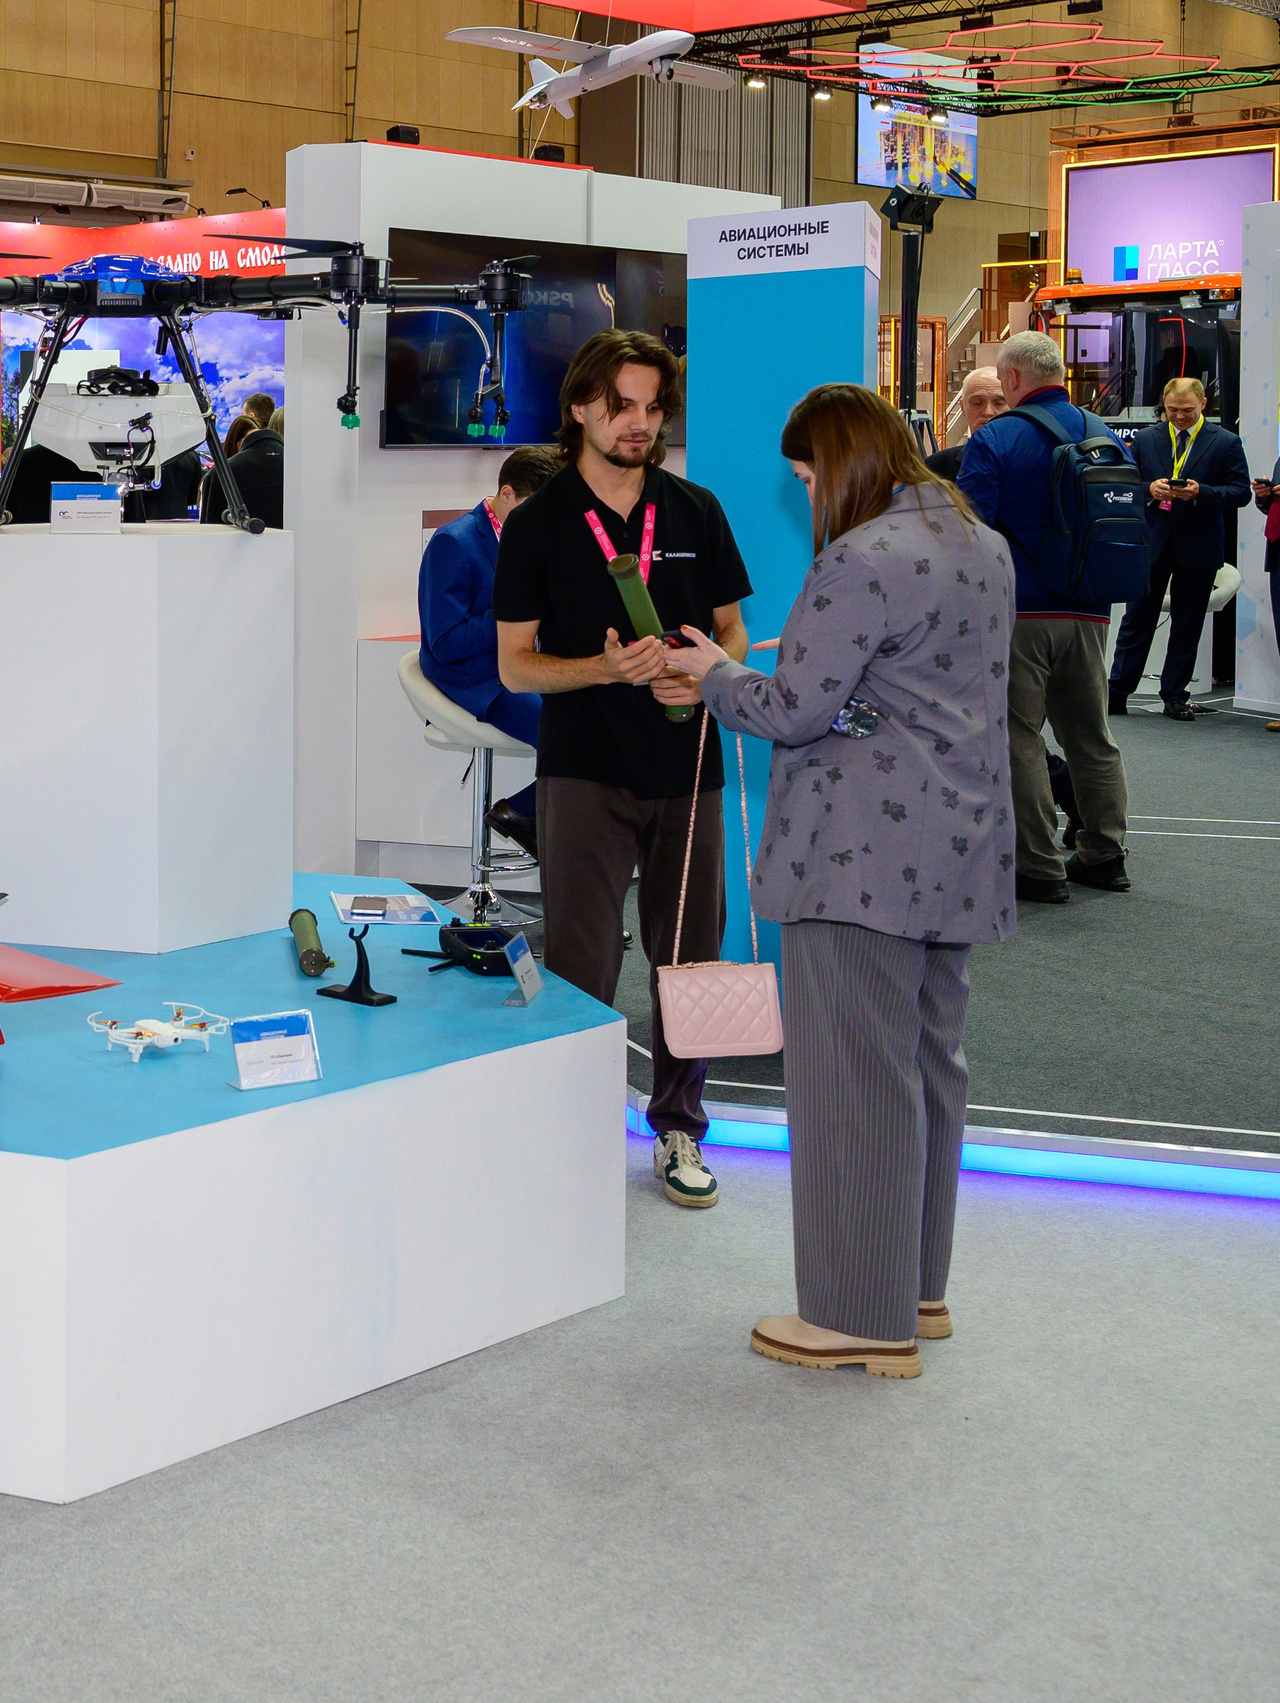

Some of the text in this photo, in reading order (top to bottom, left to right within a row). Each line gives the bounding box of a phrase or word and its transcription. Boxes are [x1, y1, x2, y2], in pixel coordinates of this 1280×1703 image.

[719, 220, 829, 243] АВИАЦИОННЫЕ
[209, 250, 229, 271] НА
[737, 242, 809, 260] СИСТЕМЫ
[1147, 240, 1220, 261] ЛАРТА
[1147, 260, 1220, 280] ГЛАСС
